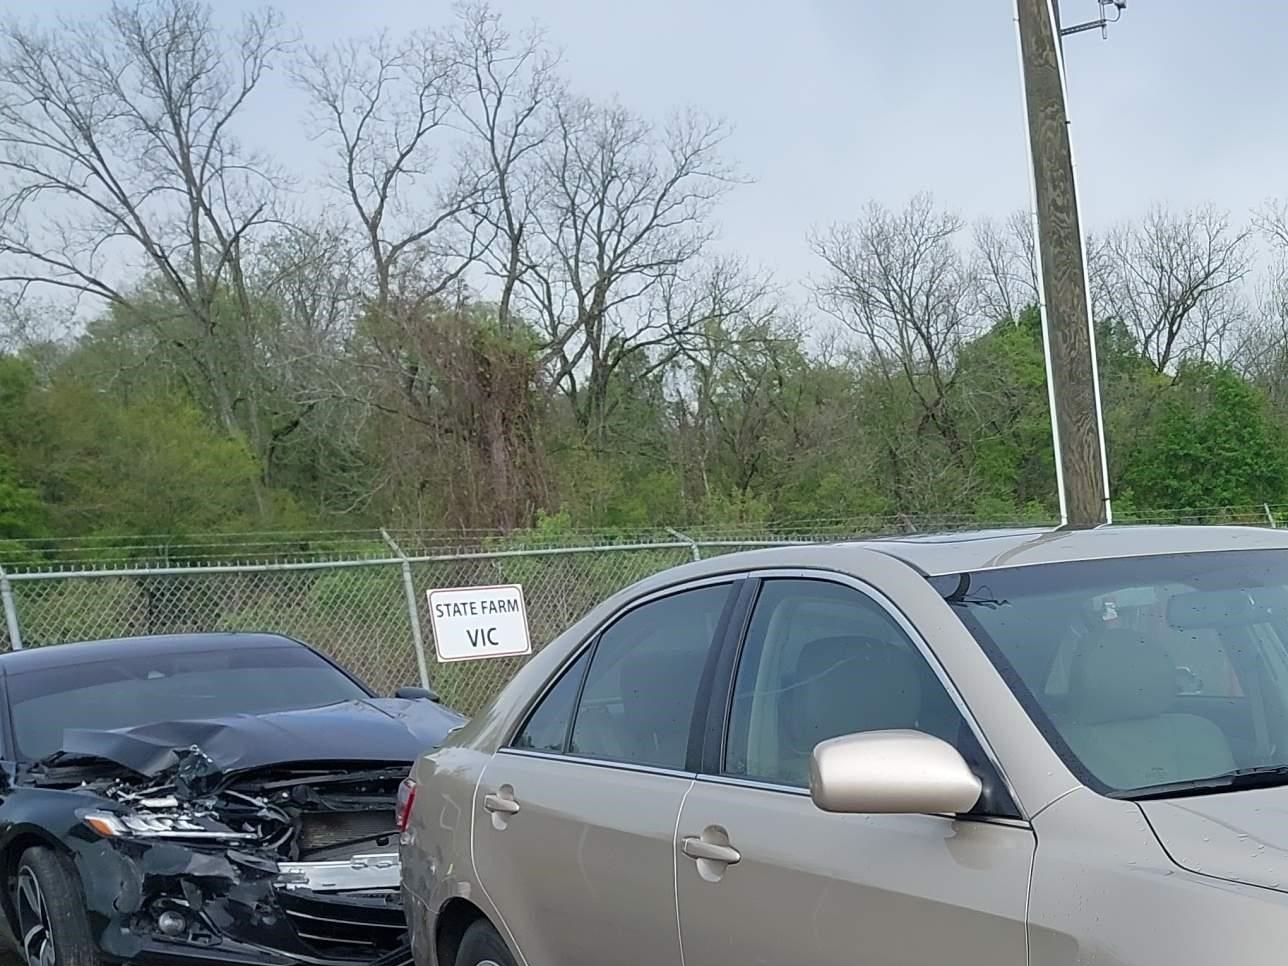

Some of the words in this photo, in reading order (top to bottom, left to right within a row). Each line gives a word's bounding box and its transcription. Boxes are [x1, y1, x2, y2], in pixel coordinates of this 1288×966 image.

[436, 602, 478, 618] STATE
[481, 599, 519, 615] FARM
[466, 628, 499, 647] VIC
